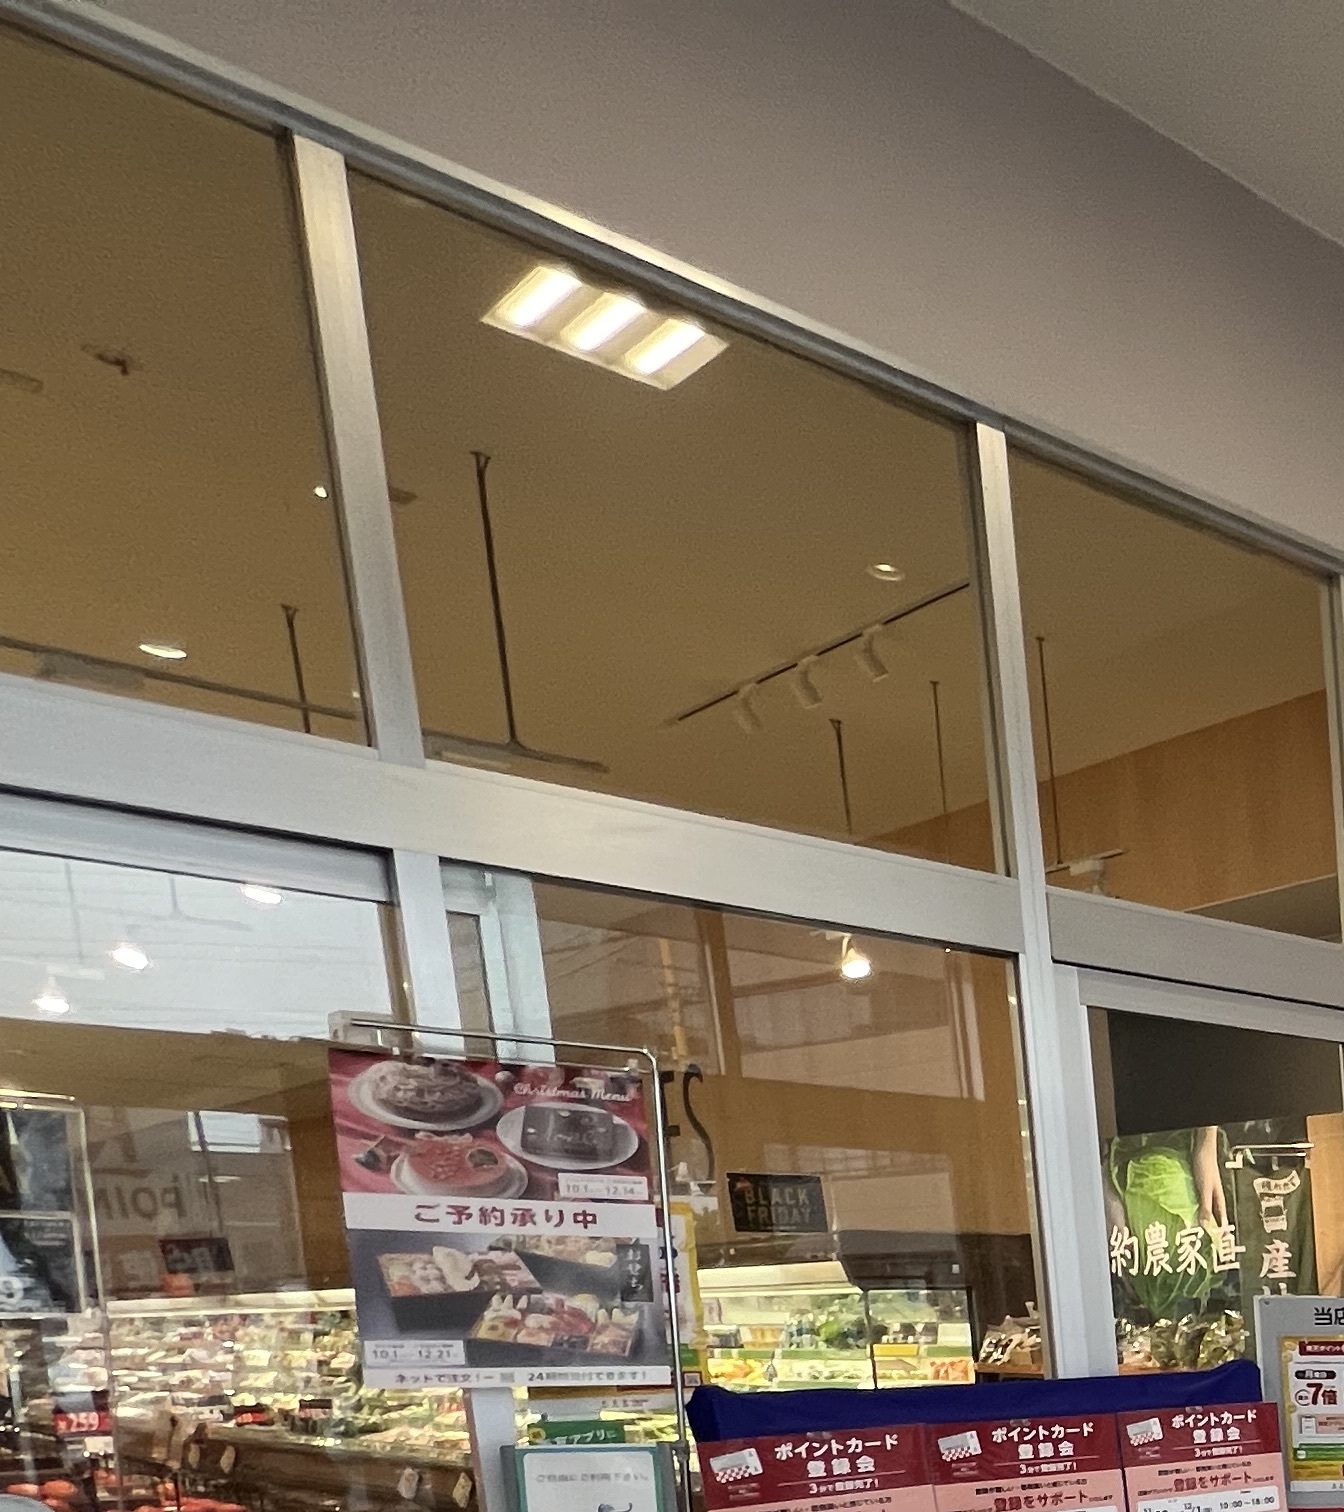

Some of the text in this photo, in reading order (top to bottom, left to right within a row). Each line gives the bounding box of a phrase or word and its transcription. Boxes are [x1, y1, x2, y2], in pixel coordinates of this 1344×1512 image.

[744, 1186, 810, 1206] BLACK
[414, 1203, 599, 1230] ご予約承り中
[1171, 1409, 1257, 1429] ポイントカード
[991, 1421, 1094, 1443] ポイントカード
[775, 1433, 899, 1461] ポイントカード
